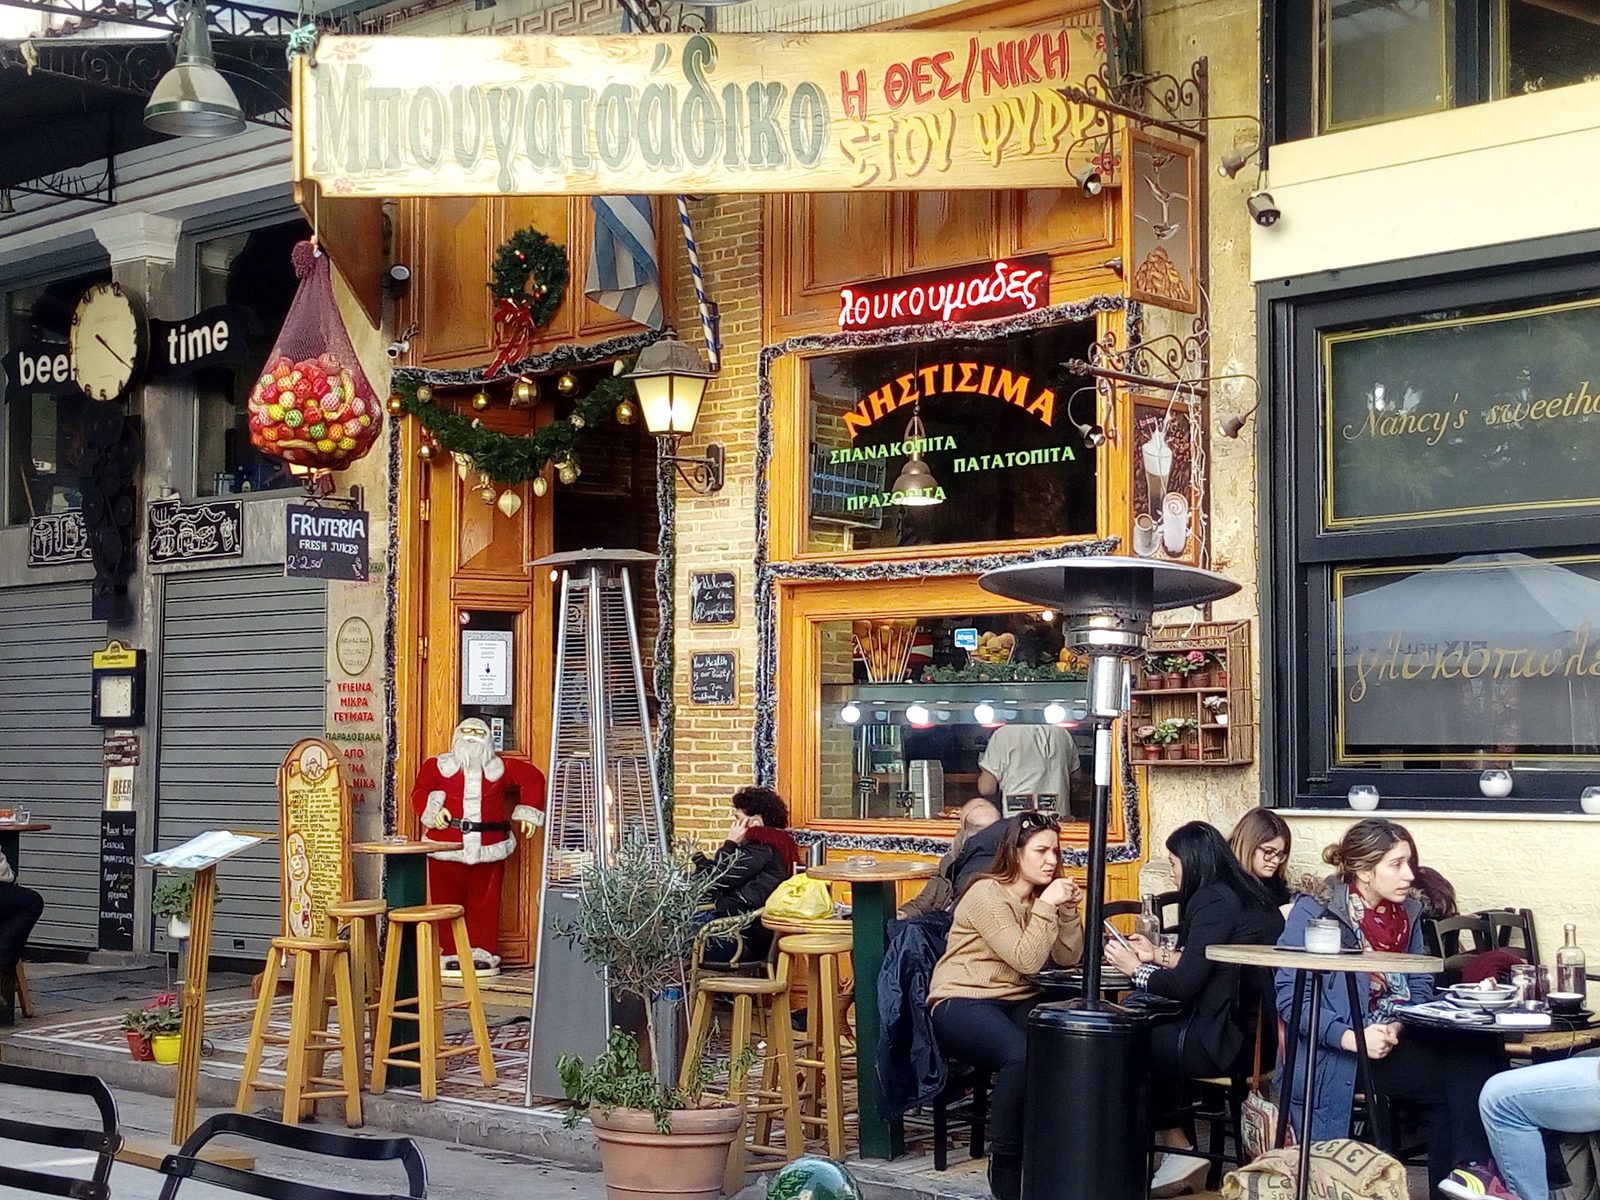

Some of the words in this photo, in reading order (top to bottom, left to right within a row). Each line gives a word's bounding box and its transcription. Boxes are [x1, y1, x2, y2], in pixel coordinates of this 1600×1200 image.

[840, 67, 867, 121] Η
[311, 34, 830, 193] Μπουγατσάδικο
[974, 82, 1112, 168] ΨΥΡΡ
[167, 319, 230, 366] time
[842, 362, 1056, 440] ΝΗΣΤΙΣΙΜΑ
[1342, 392, 1469, 446] Nancy's
[829, 435, 957, 466] ΣΠΑΝΑΚΟΠΙΤΑ
[953, 445, 1076, 474] ΠΑΤΑΤΟΠΙΤΑ
[290, 513, 366, 539] FRUTERIA
[299, 539, 327, 551] FRESH
[330, 541, 359, 555] JUICES
[334, 711, 375, 722] ΓΕΥΜΑΤΑ
[340, 697, 369, 707] ΜΙΚΡΑ
[344, 748, 365, 759] ΑΠΟ
[112, 780, 132, 795] BEER
